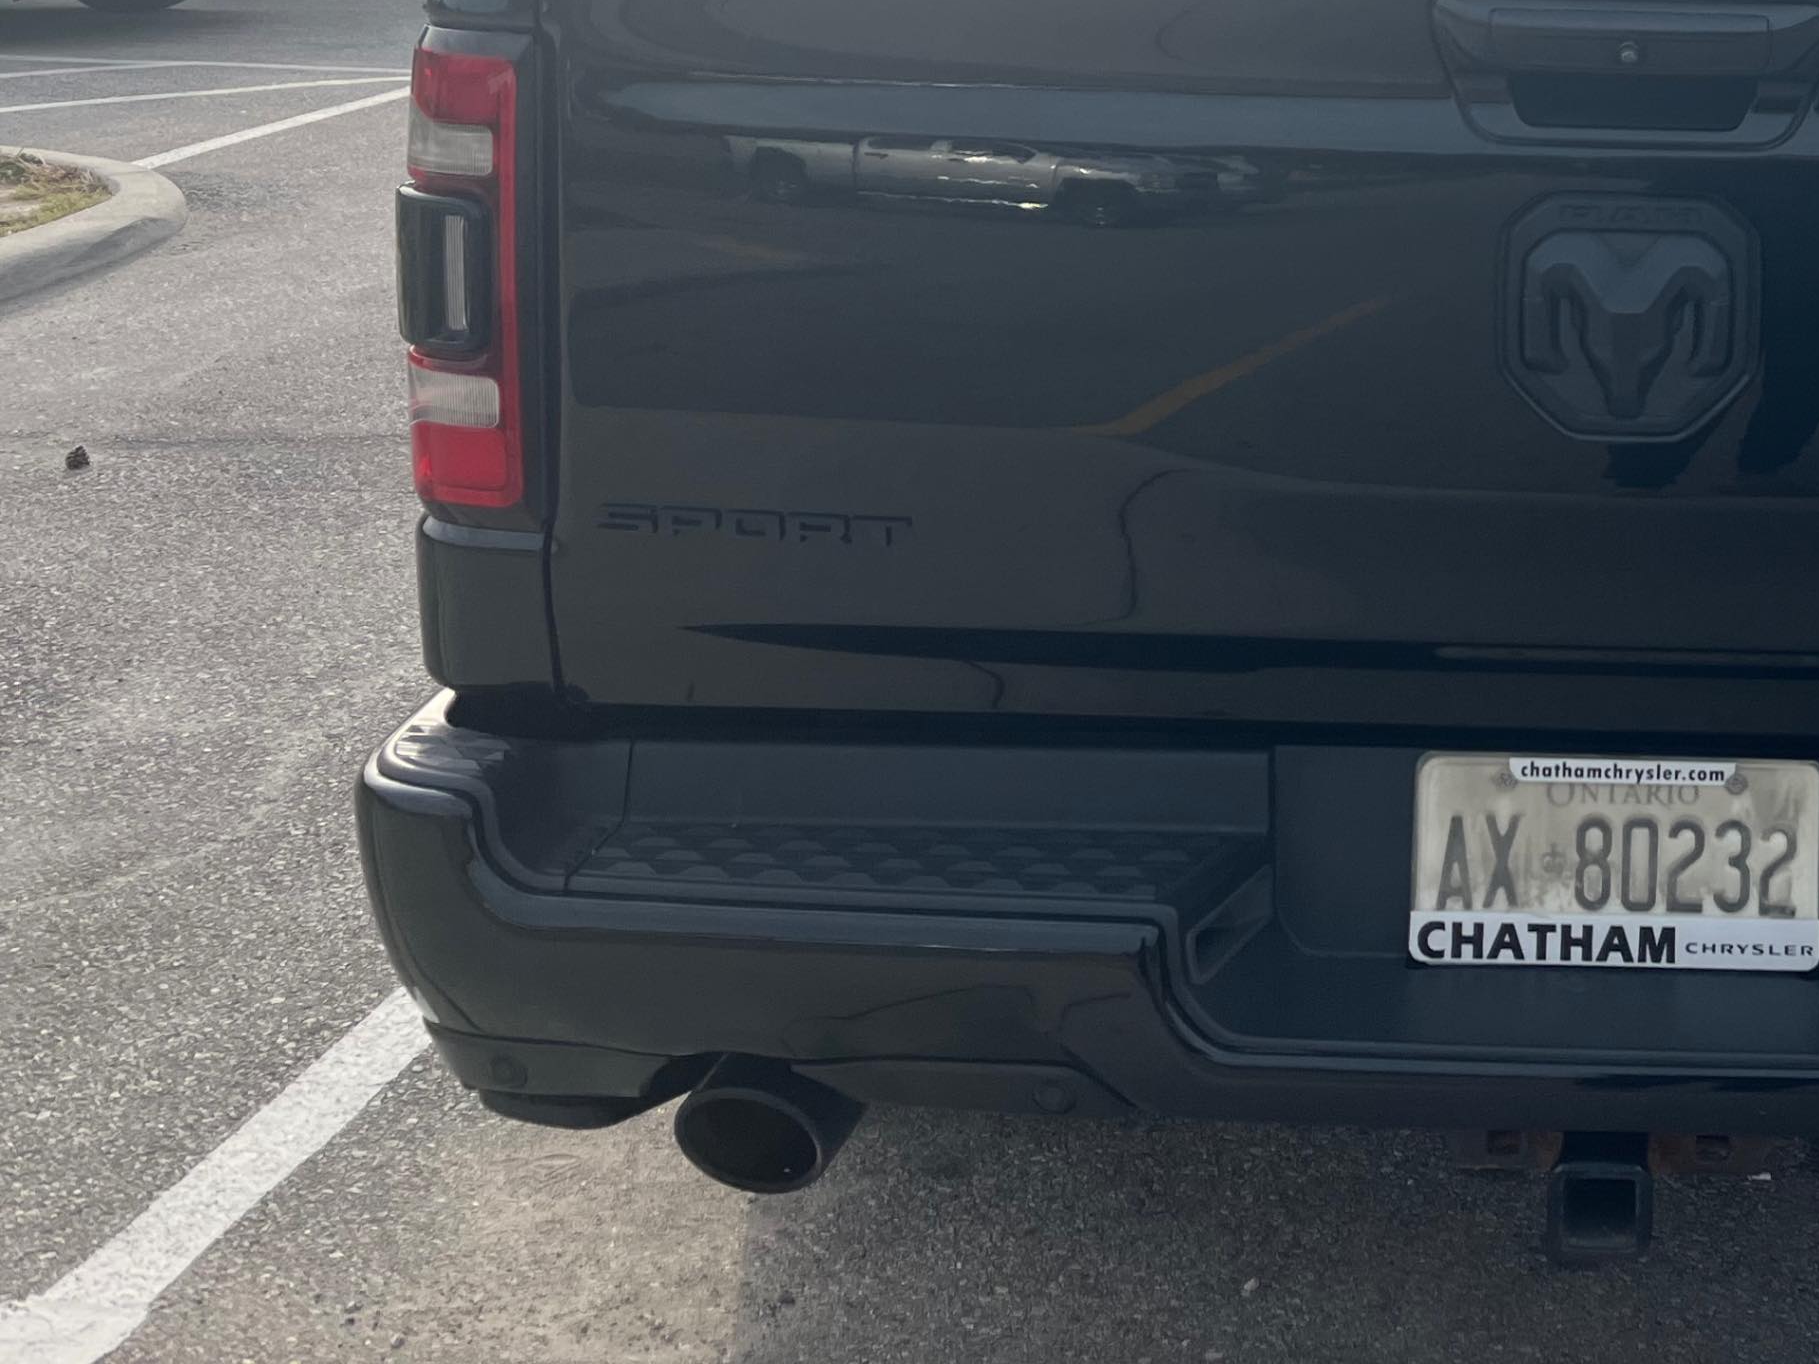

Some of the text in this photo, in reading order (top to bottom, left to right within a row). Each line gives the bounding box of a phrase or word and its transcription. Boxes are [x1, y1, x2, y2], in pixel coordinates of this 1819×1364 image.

[597, 502, 913, 547] SPORT
[1520, 760, 1726, 784] chathamchrysler.com
[1435, 814, 1798, 917] AX 80232
[1416, 920, 1815, 964] CHATHAM CHRYSLER
